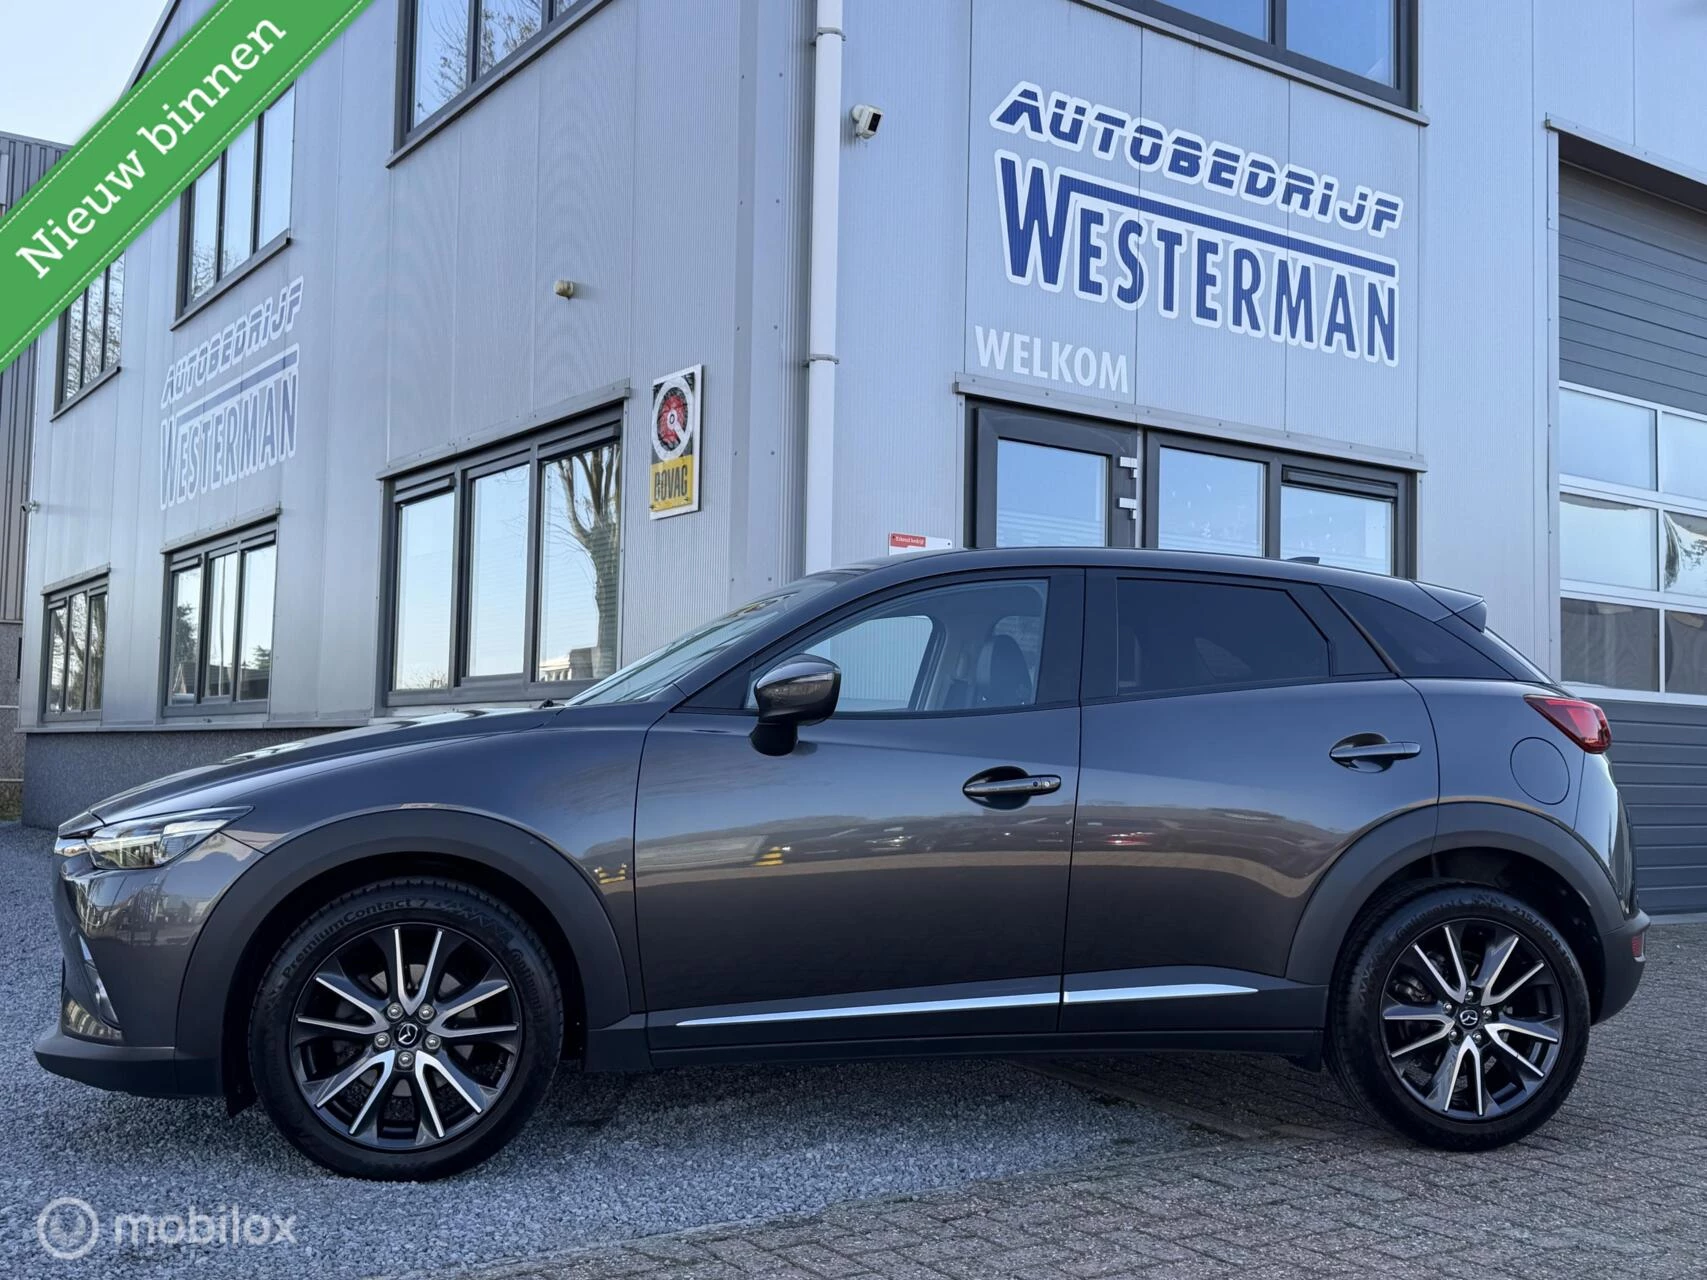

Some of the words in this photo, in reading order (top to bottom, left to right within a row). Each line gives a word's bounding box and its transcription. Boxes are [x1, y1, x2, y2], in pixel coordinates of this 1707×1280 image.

[997, 152, 1399, 365] WESTERMAN
[161, 276, 303, 408] AUTOBEDRIJF
[974, 325, 1128, 394] WELKOM
[160, 343, 300, 510] WESTERMAN
[654, 465, 688, 501] BOVAG
[282, 897, 412, 979] PremiumContact
